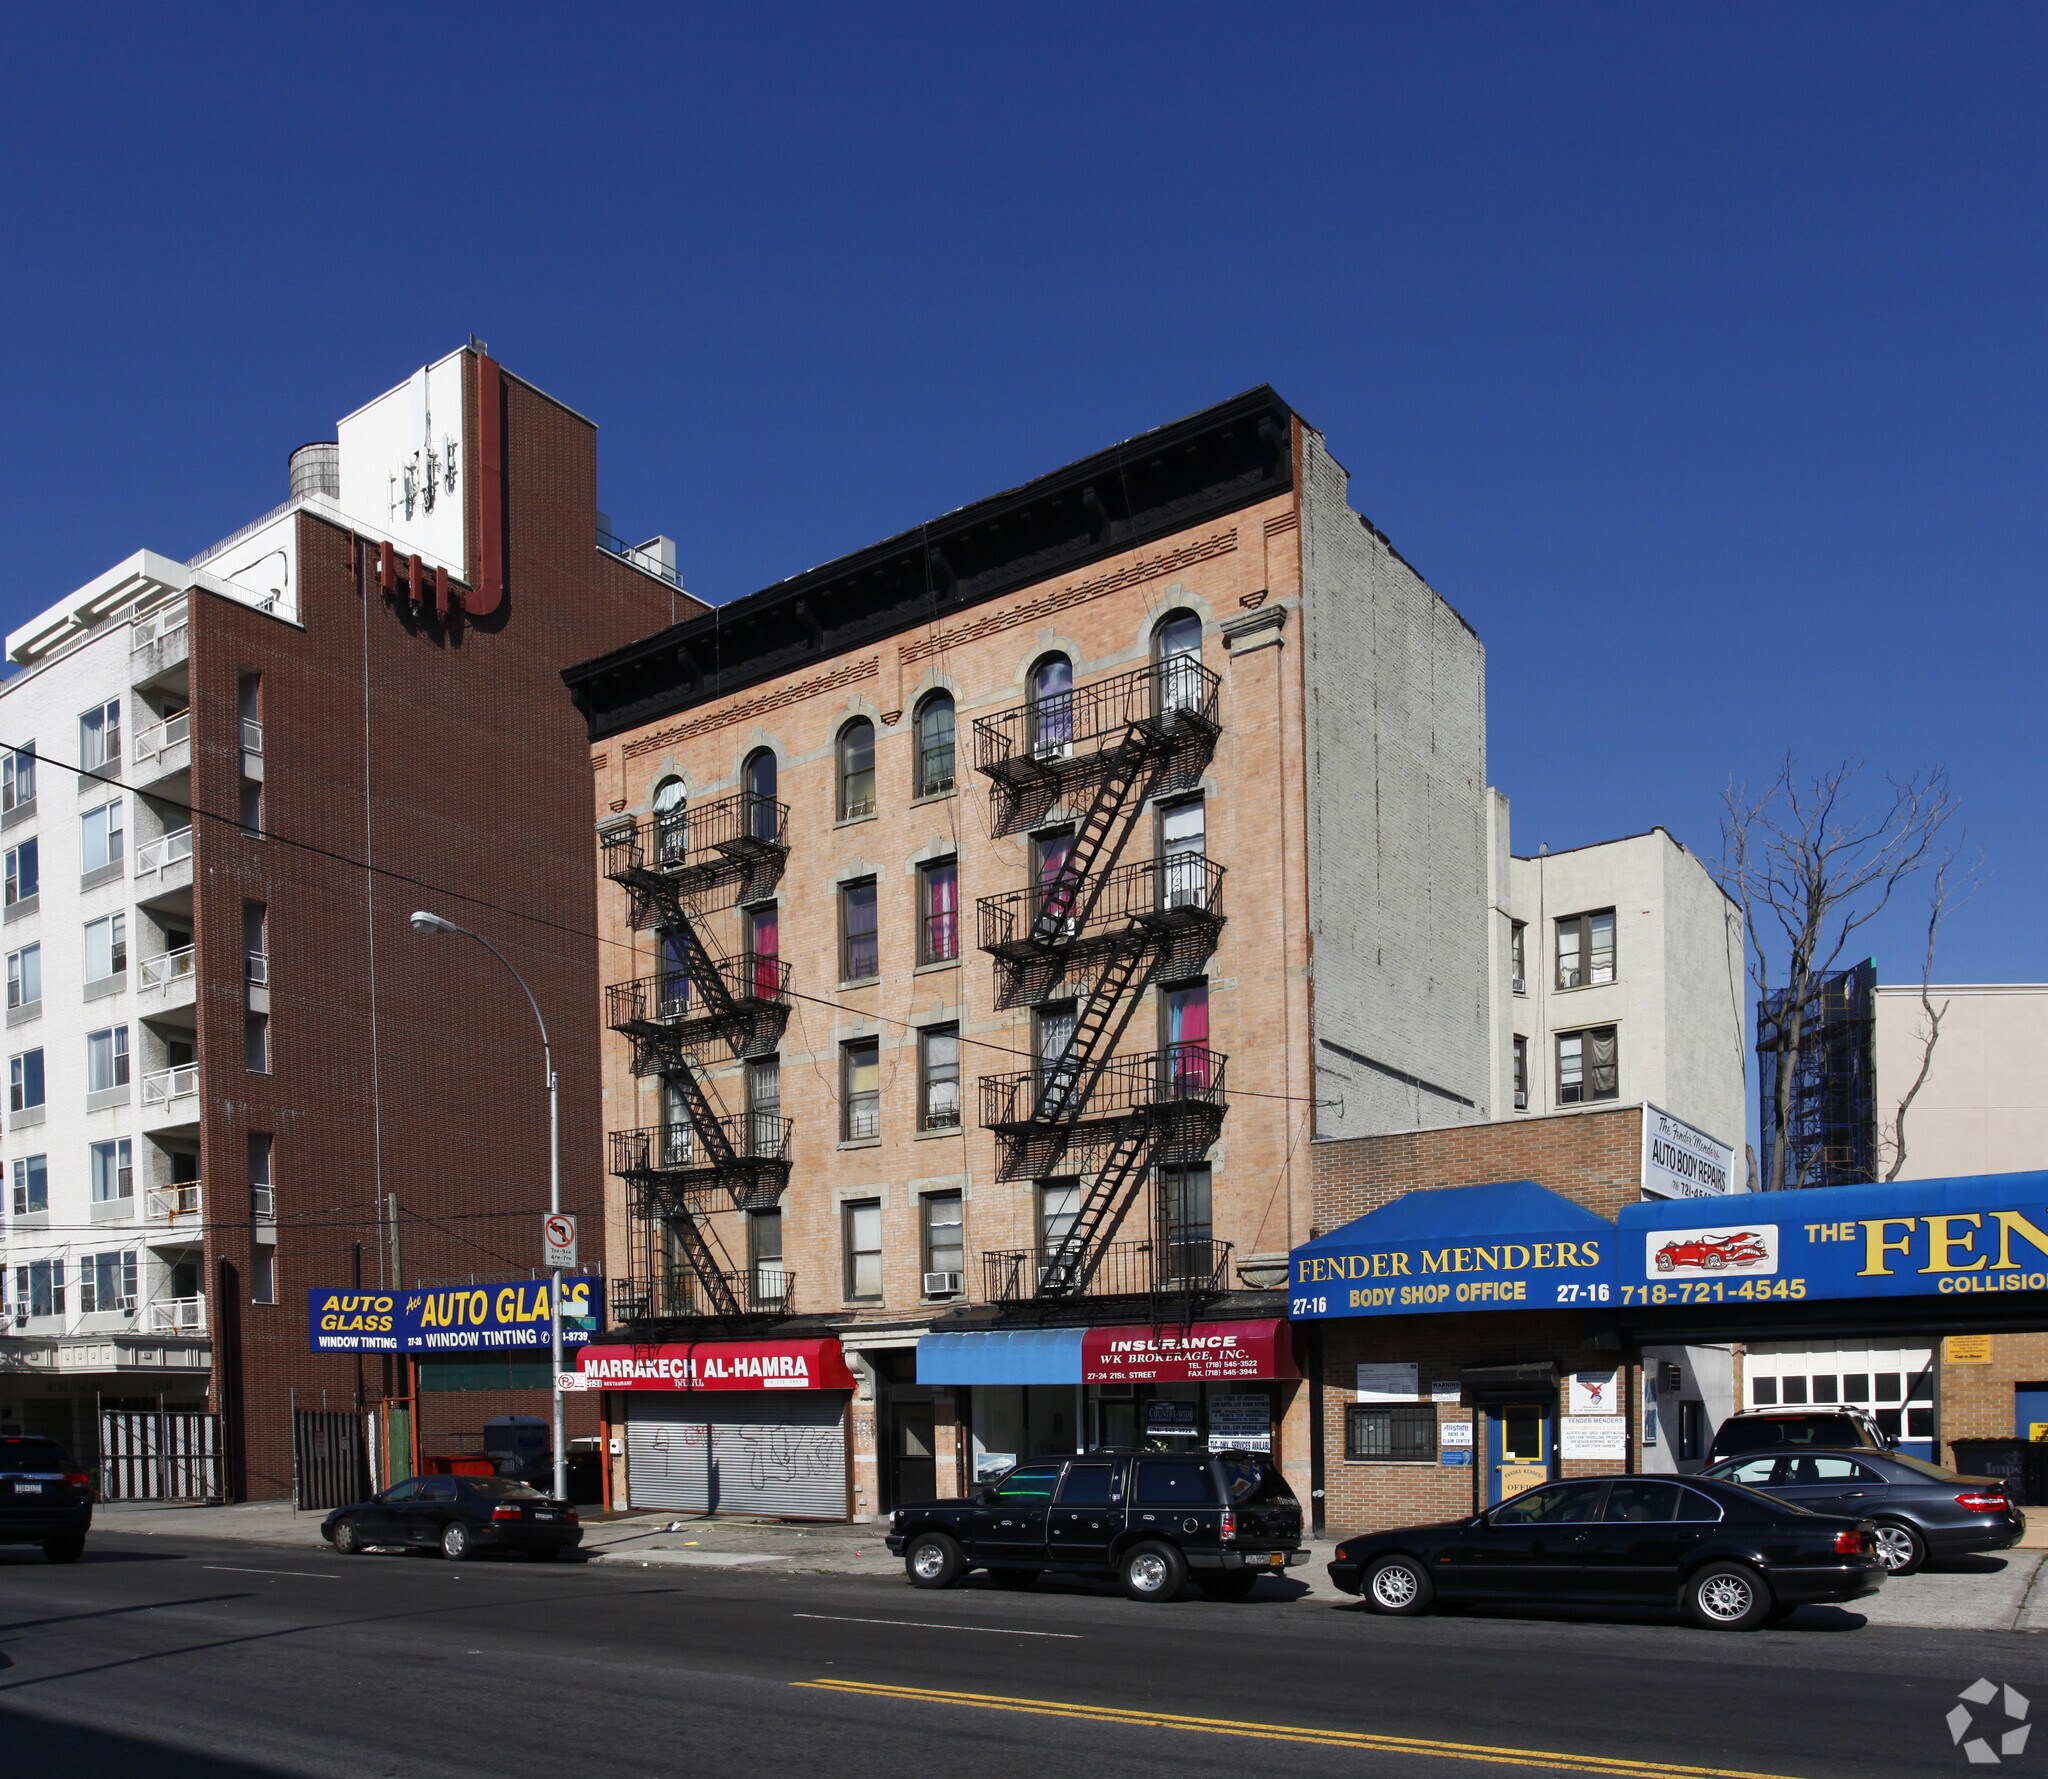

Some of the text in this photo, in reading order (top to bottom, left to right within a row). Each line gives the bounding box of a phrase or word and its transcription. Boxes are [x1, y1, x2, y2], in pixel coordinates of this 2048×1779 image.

[1659, 1117, 1720, 1160] The Fender Menders
[1652, 1139, 1726, 1192] AUTO BODY REPAIRS
[1681, 1183, 1711, 1197] 721-45
[1804, 1210, 2048, 1277] THE FEN
[1297, 1240, 1600, 1283] FENDER MENDERS
[1621, 1278, 1807, 1306] 718-721-4545
[1938, 1273, 2048, 1294] COLLISIO
[1350, 1281, 1527, 1308] BODY SHOP OFFICE
[1557, 1284, 1610, 1302] 27-16
[322, 1296, 394, 1313] AUTO
[420, 1290, 488, 1328] AUTO
[1292, 1296, 1327, 1315] 27-16
[321, 1314, 394, 1332] GLASS
[318, 1336, 398, 1349] WINDOW TINTING
[425, 1332, 479, 1348] WINDOW
[482, 1328, 537, 1345] TINTING
[1110, 1335, 1238, 1352] INSURANCE
[1100, 1349, 1250, 1364] WK BROKERAGE, INC.
[1205, 1361, 1222, 1369] (718)
[1224, 1360, 1258, 1368] 545-3522
[584, 1359, 697, 1379] MARRAKECH
[704, 1356, 809, 1378] AL-HAMRA
[1087, 1370, 1157, 1380] 27-24 21St. STREET
[1205, 1369, 1221, 1377] (718)
[1223, 1368, 1258, 1376] 545-3944
[1231, 1441, 1251, 1450] SERVICES
